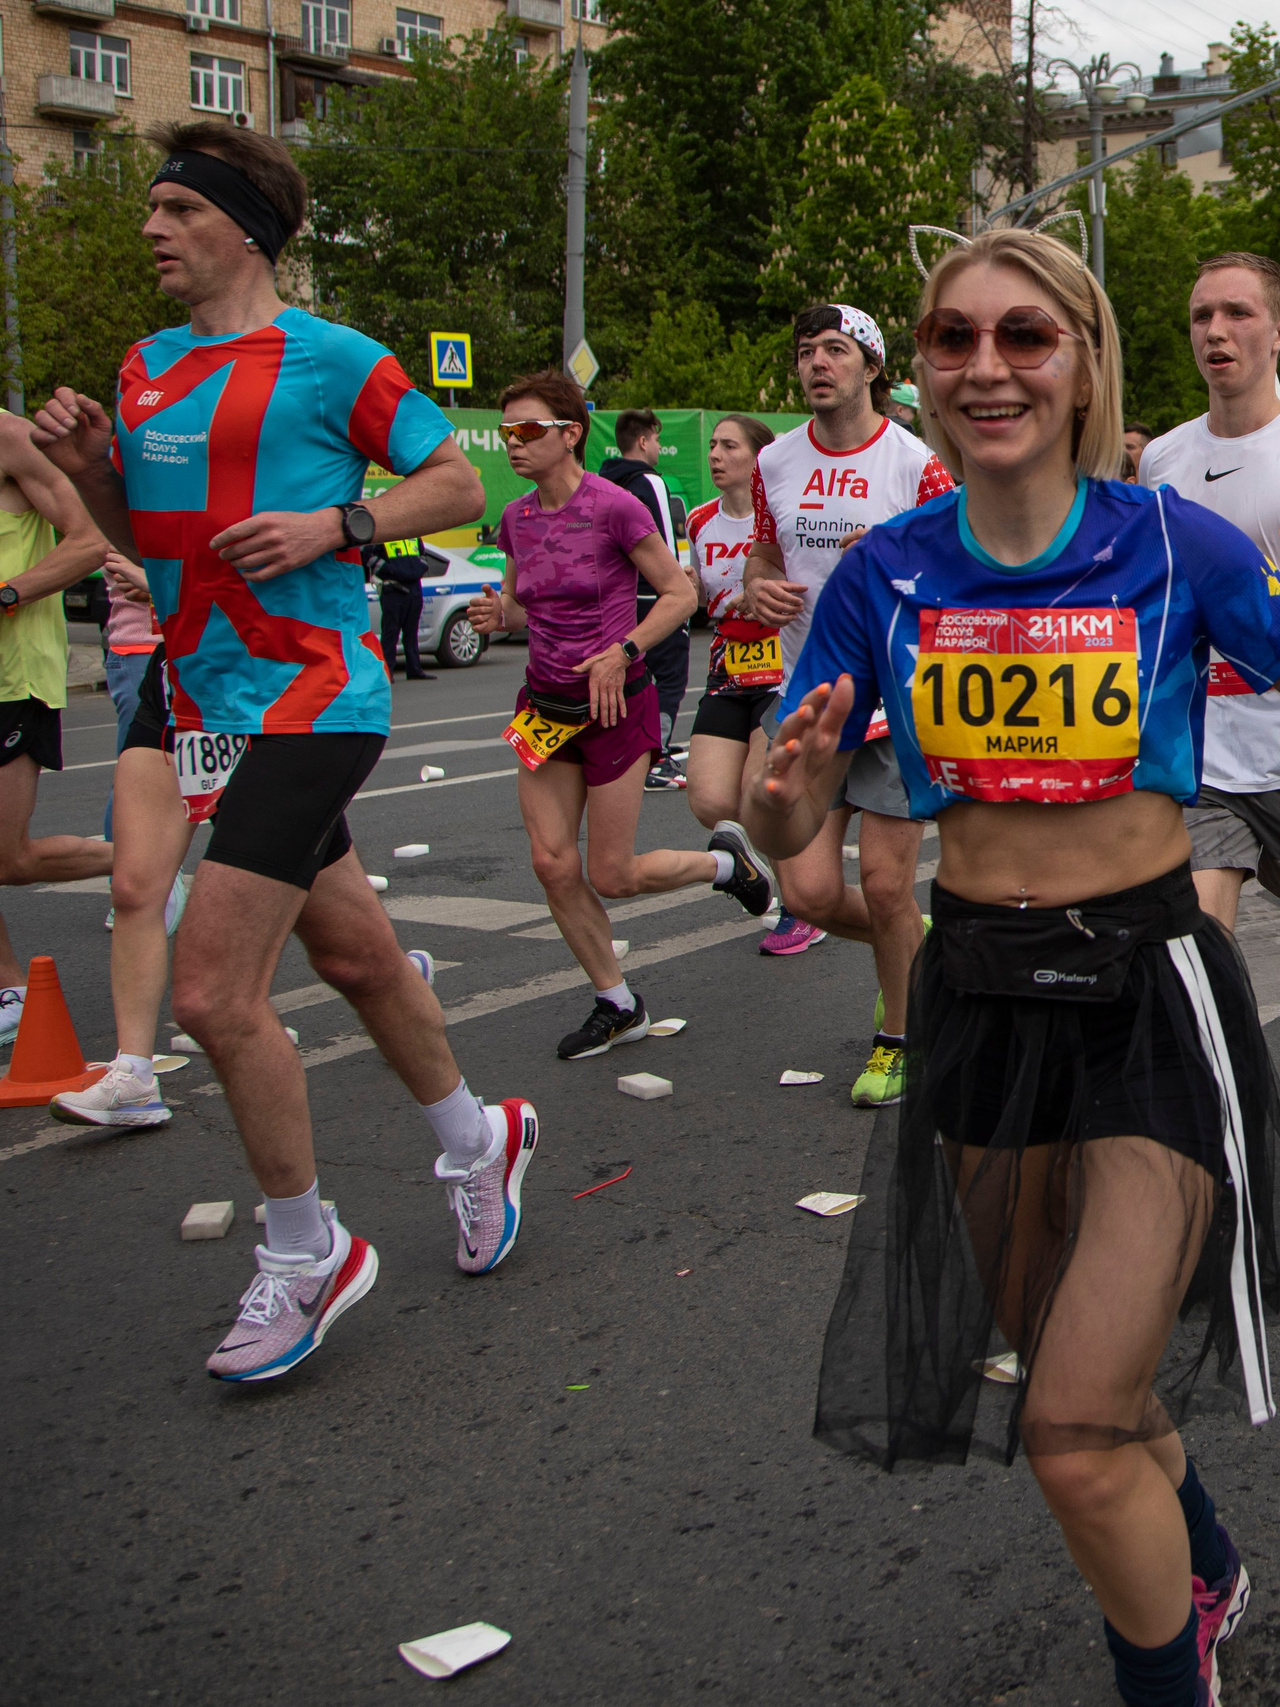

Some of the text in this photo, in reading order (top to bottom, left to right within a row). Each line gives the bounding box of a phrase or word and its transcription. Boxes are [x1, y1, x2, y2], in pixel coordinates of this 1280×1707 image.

[802, 468, 869, 499] Alfa
[728, 639, 777, 665] 1231
[934, 637, 988, 648] МАРАФОН
[1084, 637, 1114, 647] 2023
[747, 661, 771, 670] МАРИЯ
[921, 662, 1132, 727] 10216
[524, 711, 581, 749] 126
[986, 735, 1059, 753] МАРИЯ
[938, 760, 966, 793] E
[1057, 972, 1098, 985] Kalenji
